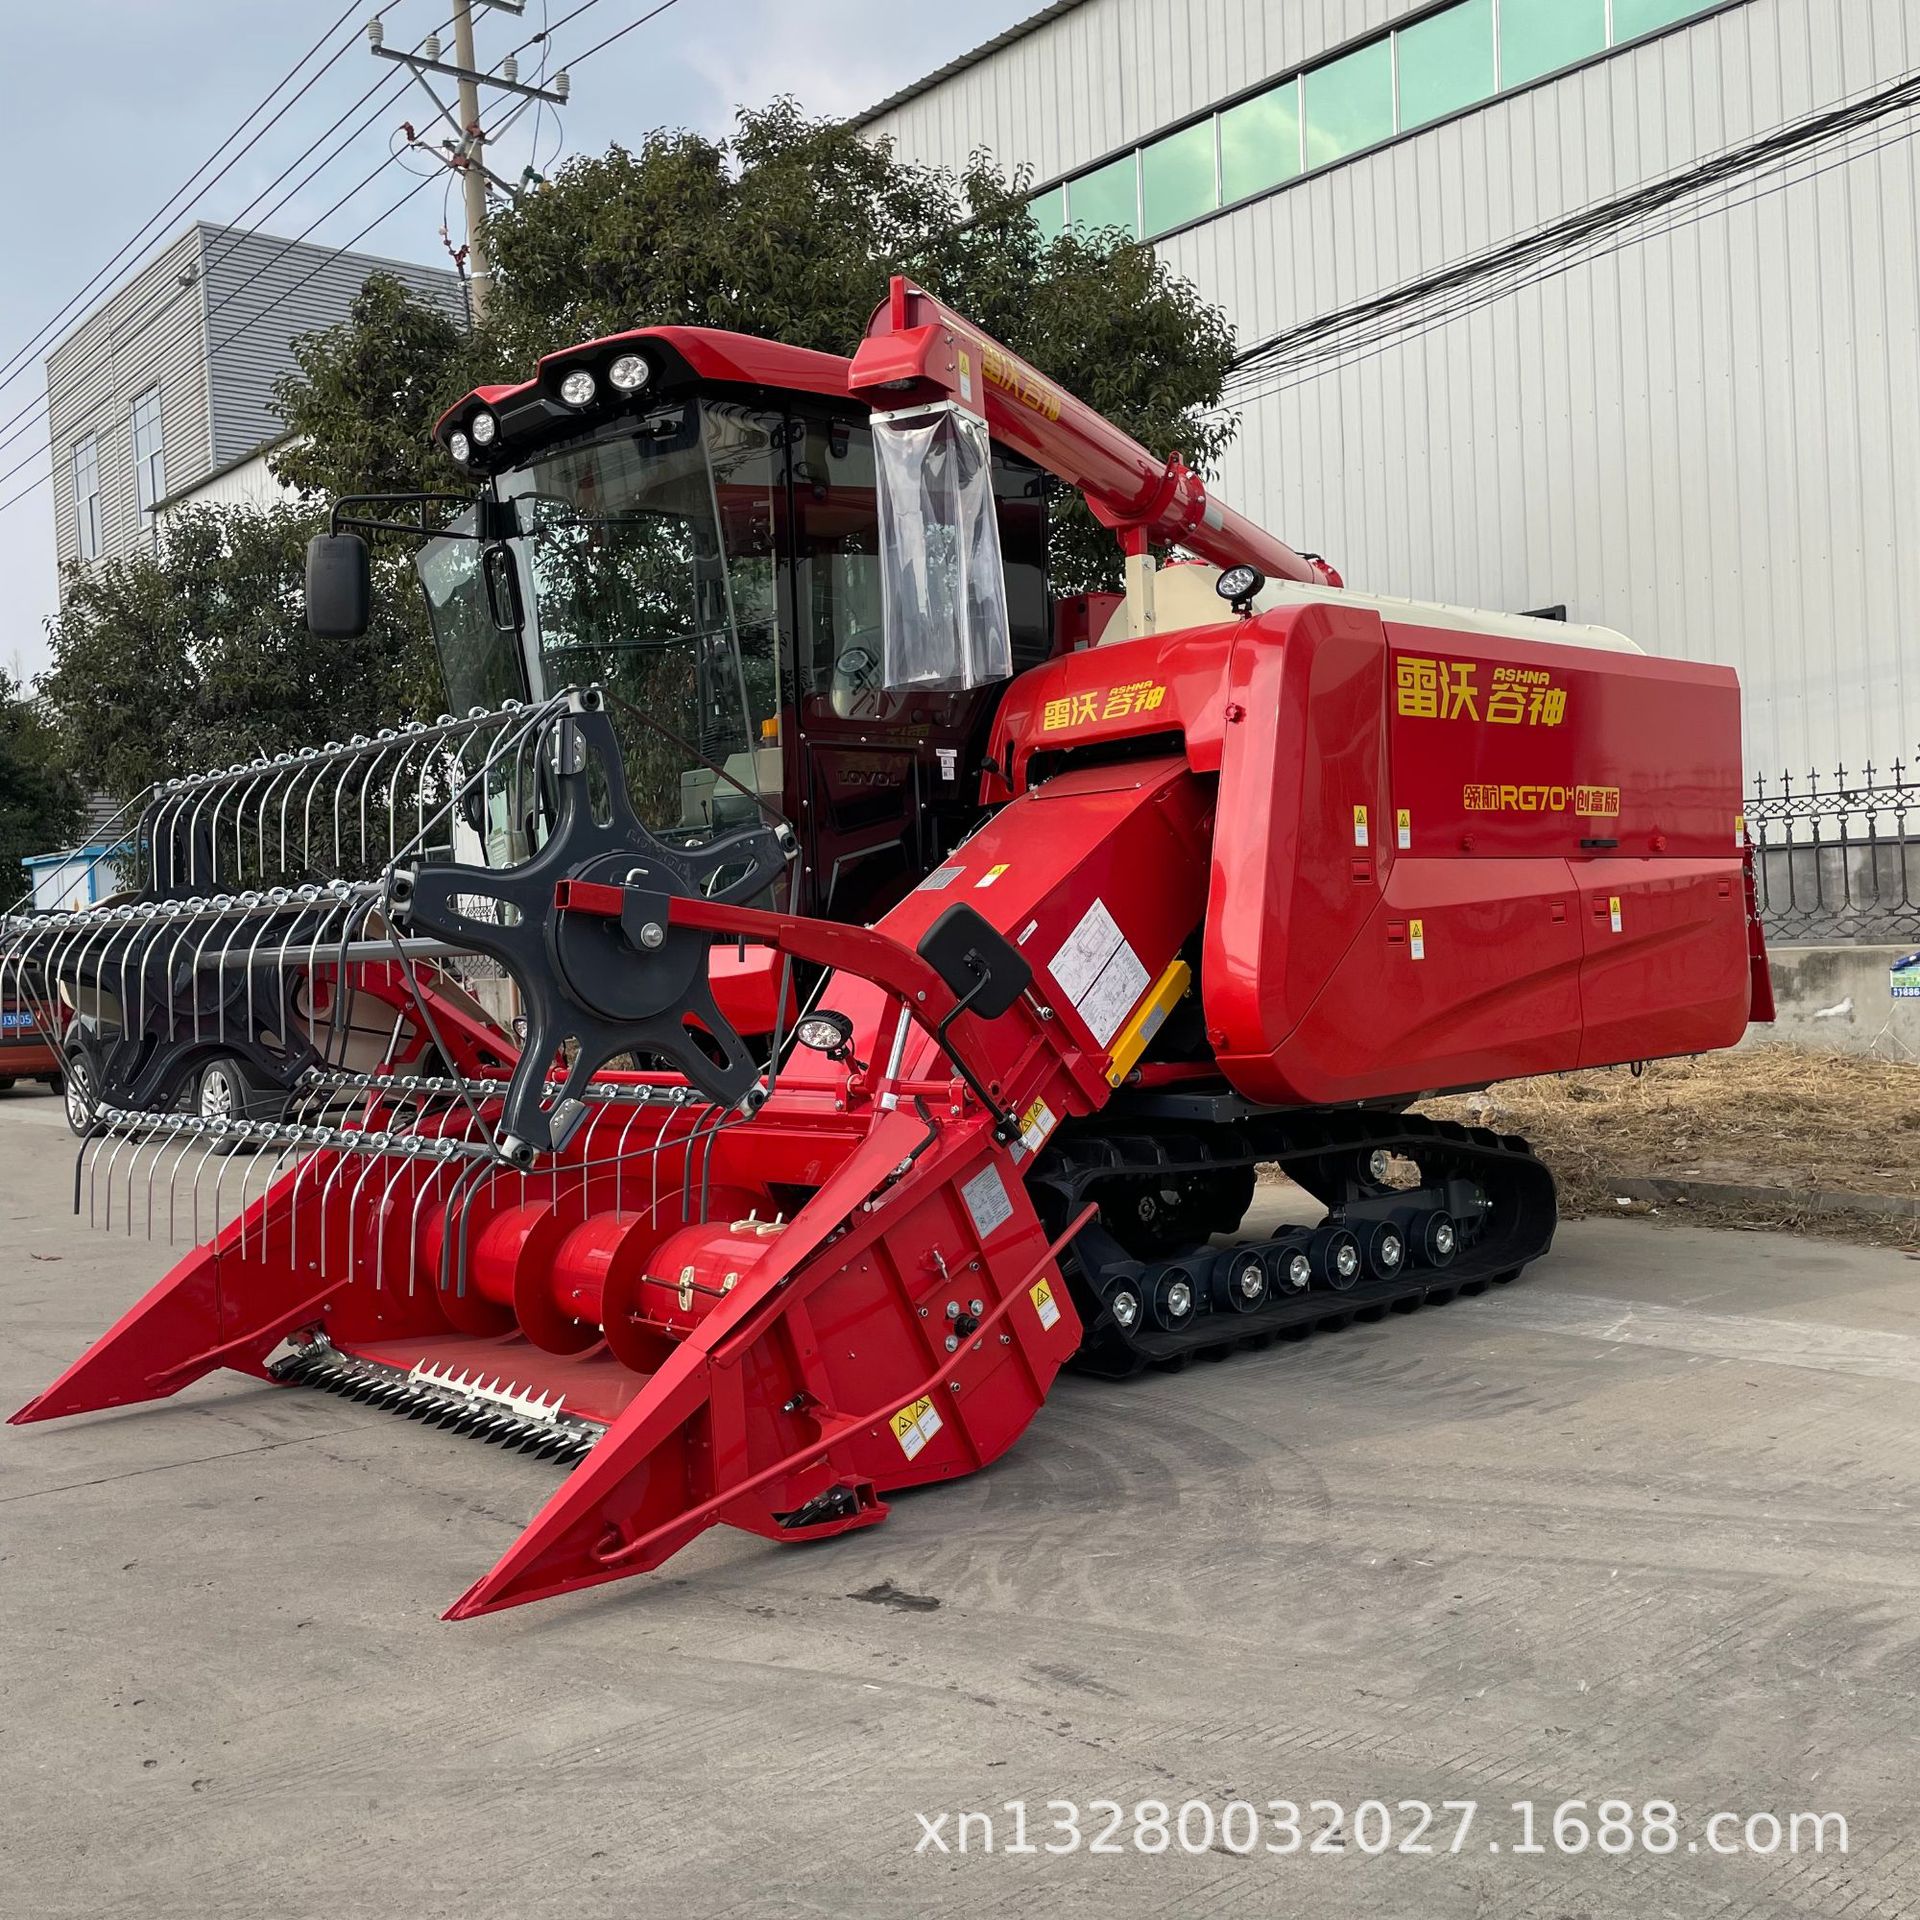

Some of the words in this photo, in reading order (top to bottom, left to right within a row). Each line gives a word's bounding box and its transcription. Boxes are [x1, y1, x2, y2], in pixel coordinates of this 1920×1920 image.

[1493, 667, 1550, 686] ASHNA
[1109, 680, 1153, 696] ASHNA
[1576, 788, 1619, 814] 创富版
